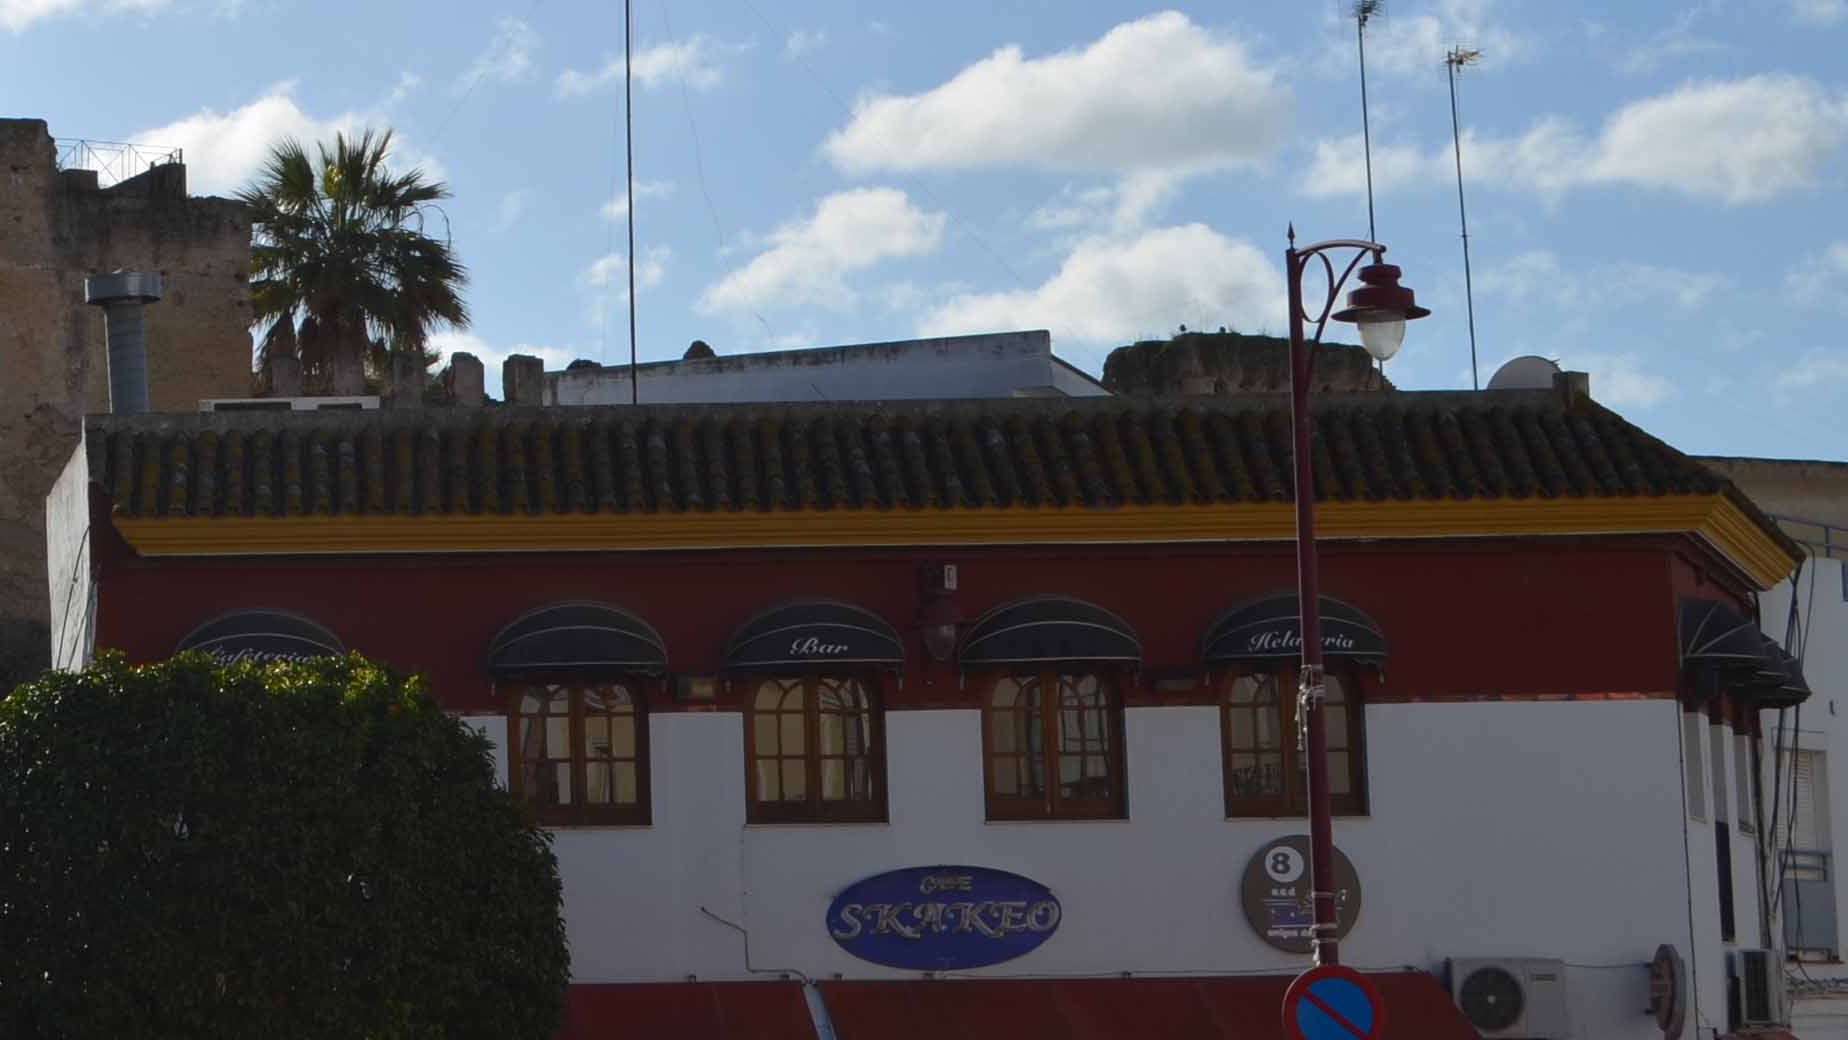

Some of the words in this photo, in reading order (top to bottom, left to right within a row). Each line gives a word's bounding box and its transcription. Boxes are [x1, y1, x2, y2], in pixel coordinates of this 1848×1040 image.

[789, 637, 849, 655] Bar
[1248, 630, 1354, 653] Helaria
[1271, 852, 1291, 874] 8
[832, 899, 1061, 939] SKAKEO
